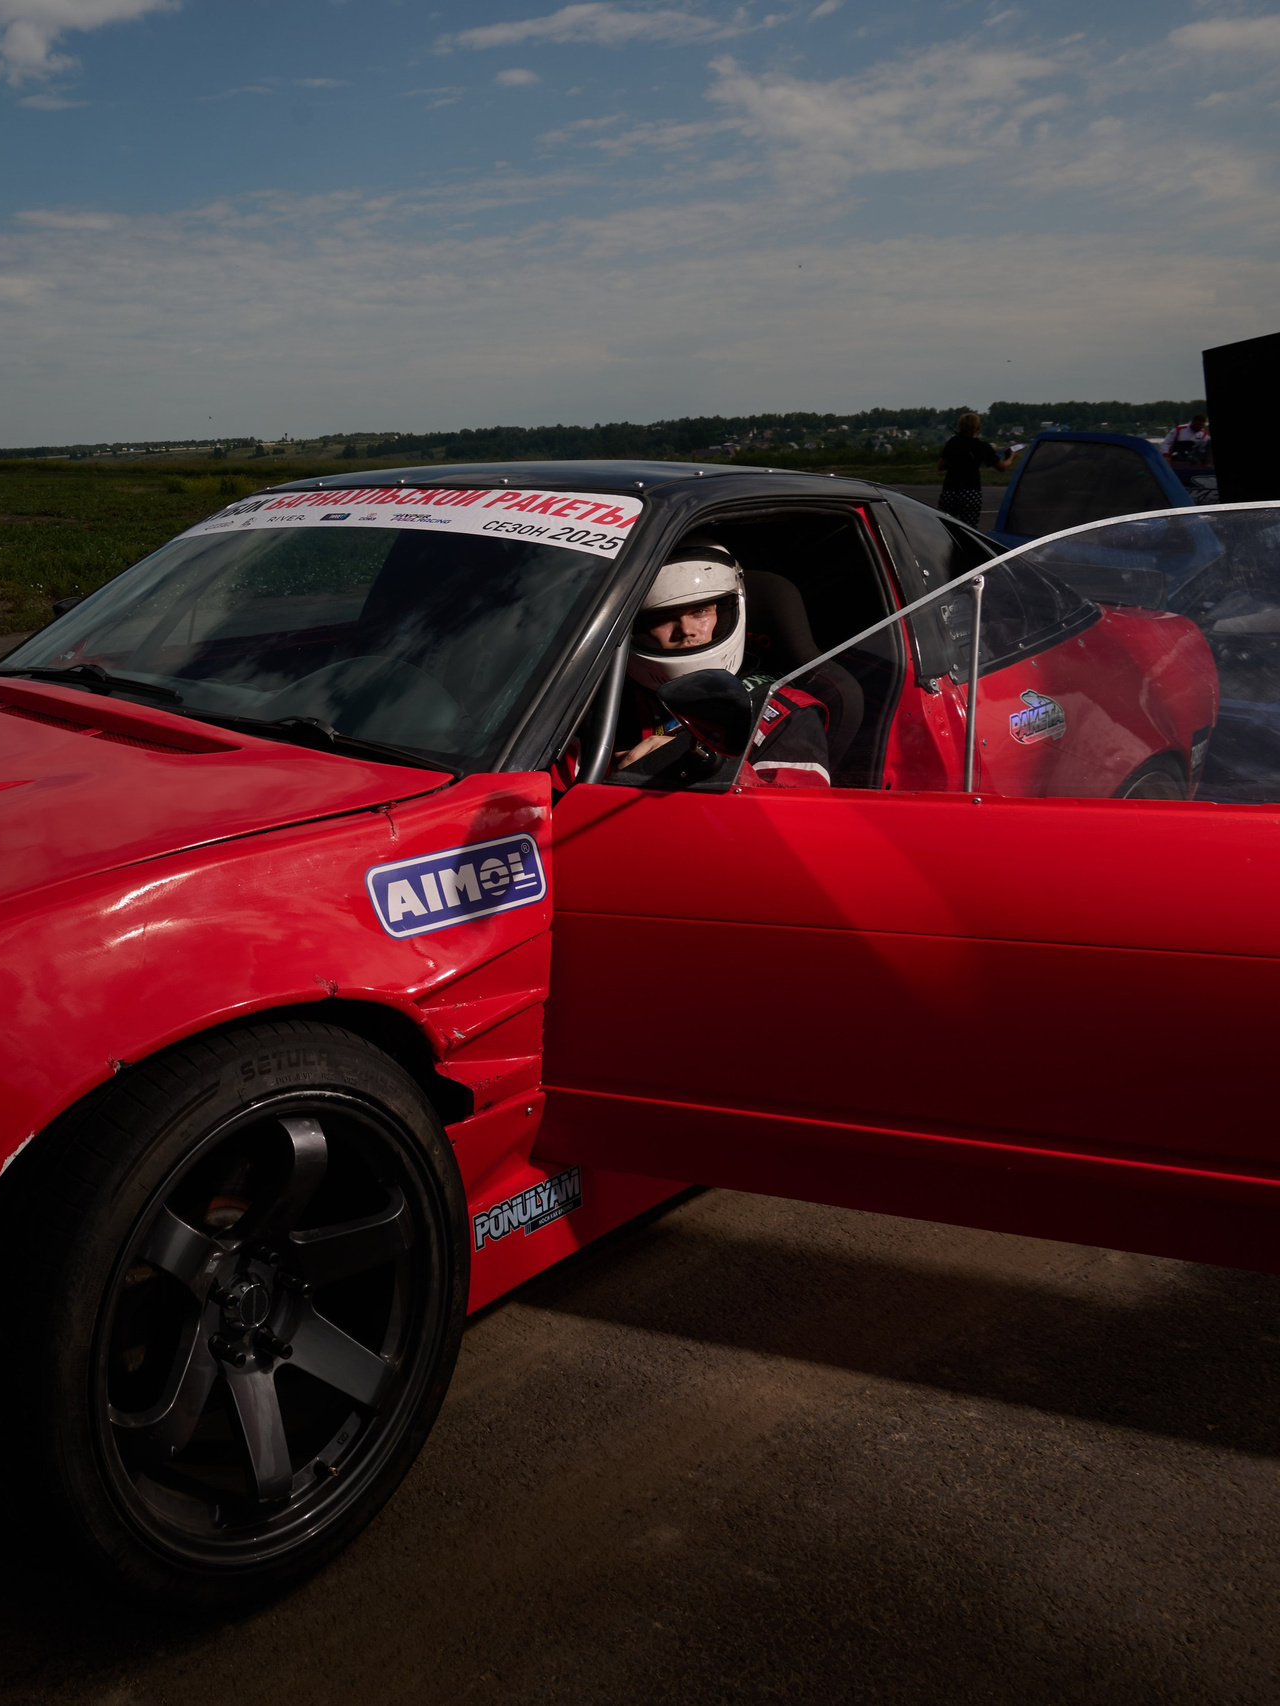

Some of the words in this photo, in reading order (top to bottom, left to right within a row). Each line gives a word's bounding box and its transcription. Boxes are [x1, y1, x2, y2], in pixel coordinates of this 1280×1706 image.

[267, 514, 306, 523] RIVER
[482, 491, 639, 529] РАКЕТЫ
[482, 520, 551, 537] СЕЗОН
[547, 527, 626, 551] 2025
[387, 851, 536, 923] AIMOL
